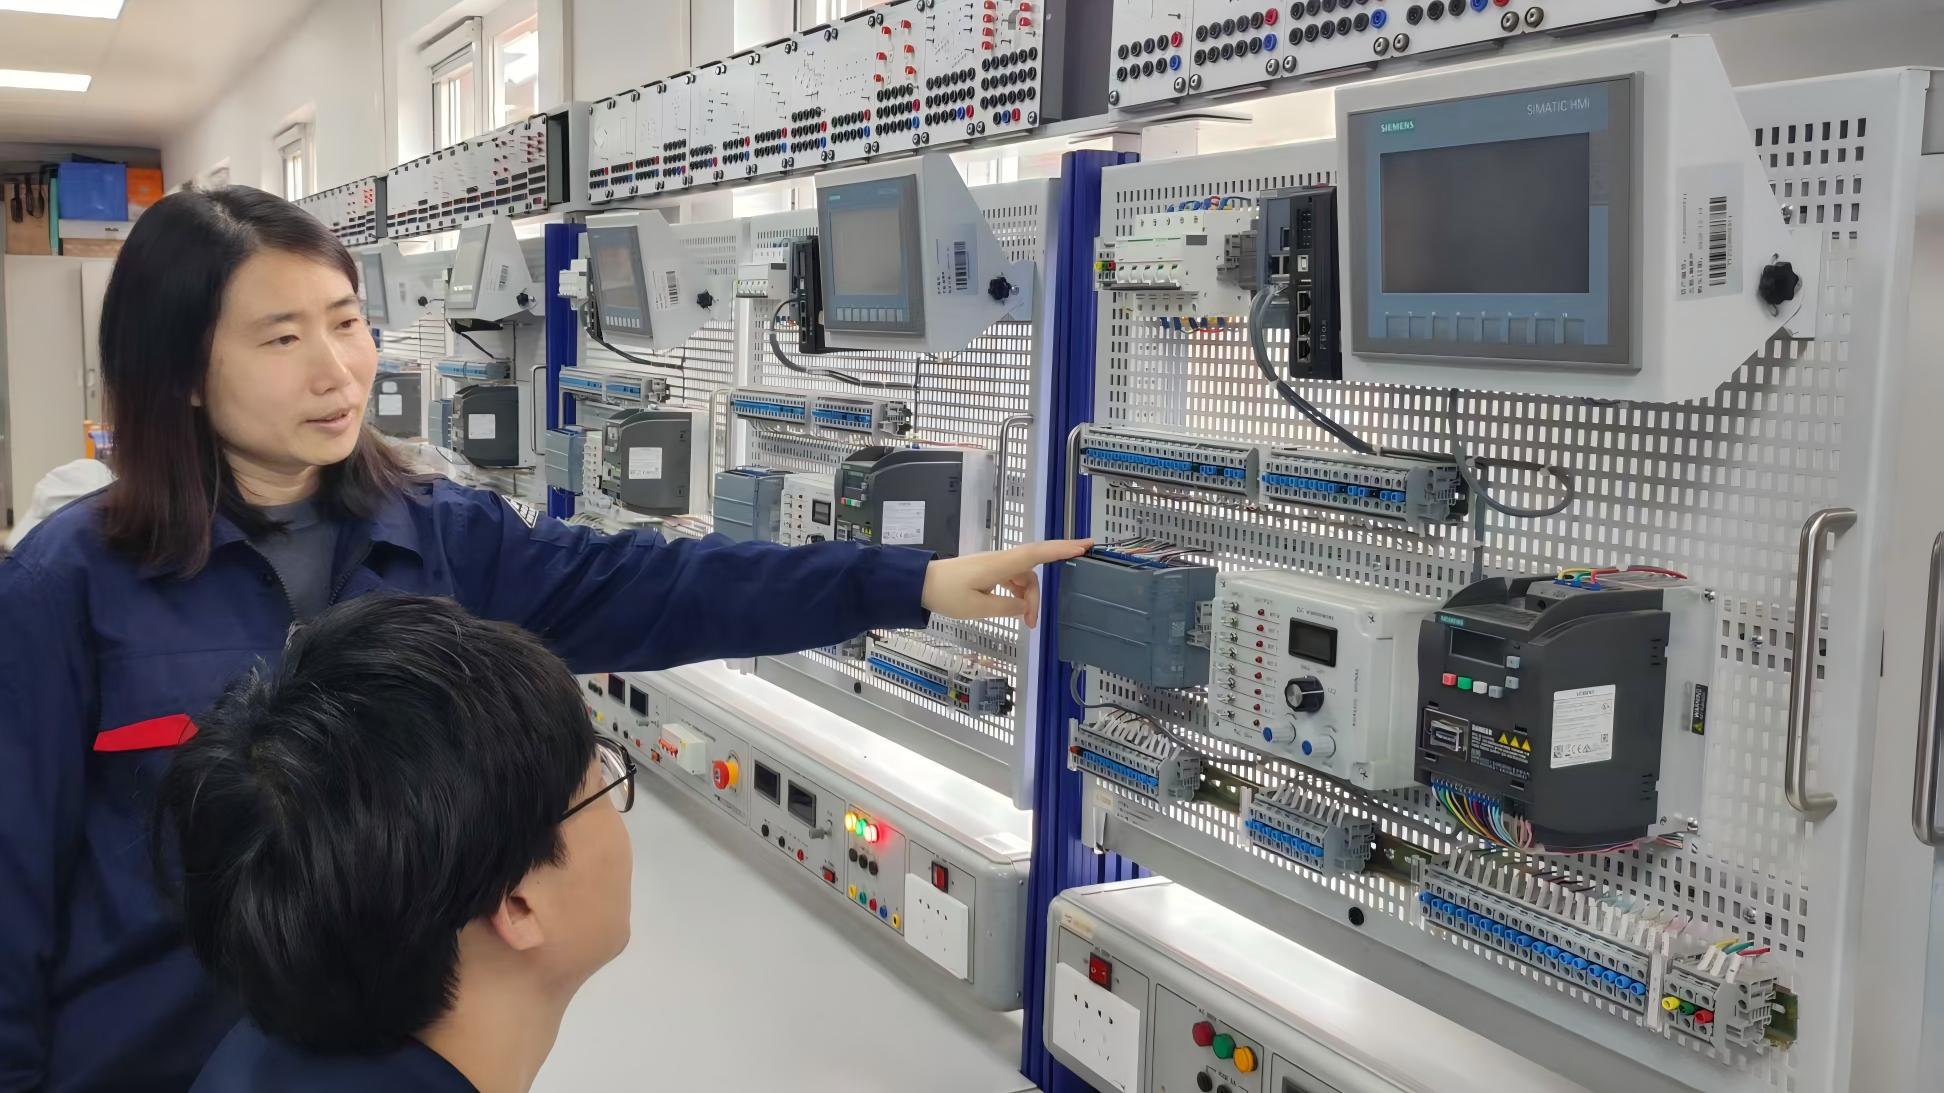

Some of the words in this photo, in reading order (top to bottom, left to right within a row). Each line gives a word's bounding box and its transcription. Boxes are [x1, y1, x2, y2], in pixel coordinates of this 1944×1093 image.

[1527, 101, 1567, 115] SIMATIC
[1570, 97, 1590, 110] HMI
[1380, 120, 1414, 133] SIEMENS
